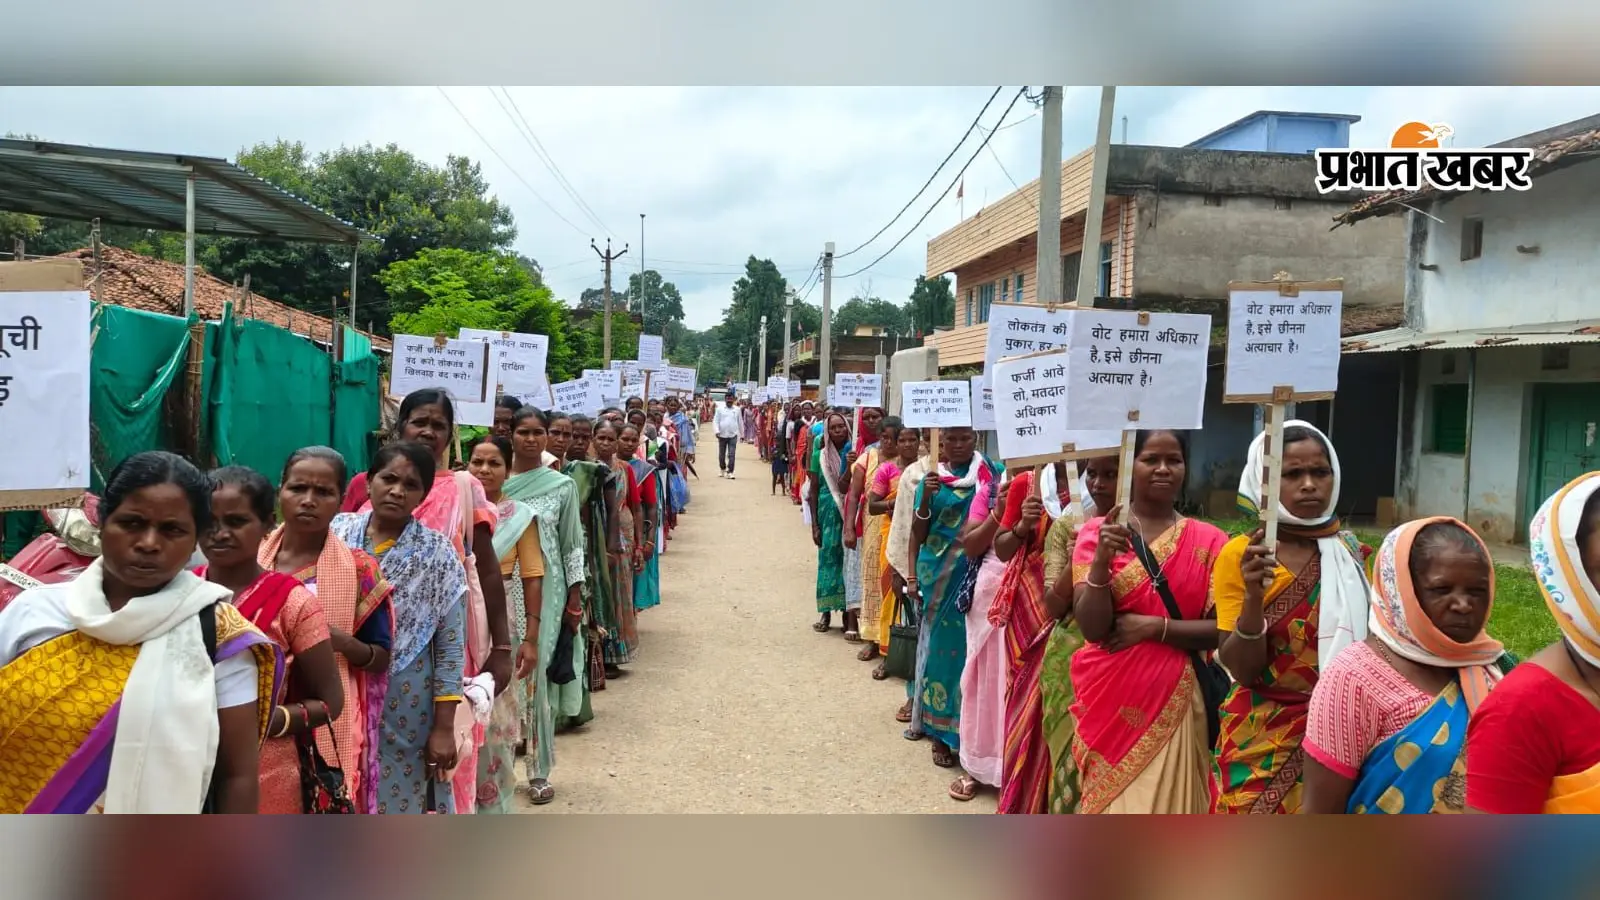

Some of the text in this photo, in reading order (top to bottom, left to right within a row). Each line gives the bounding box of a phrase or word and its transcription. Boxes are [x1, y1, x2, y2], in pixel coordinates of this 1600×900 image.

[1247, 301, 1332, 316] वोट हमारा अधिकार
[1007, 318, 1067, 335] लोकतंत्र की
[1091, 323, 1199, 344] वोट हमारा अधिकार
[1258, 320, 1272, 334] इसे
[1278, 320, 1306, 334] छीनना
[1005, 338, 1035, 351] पुकार,
[1038, 341, 1053, 351] हर
[1245, 342, 1282, 353] अत्याचार
[1104, 347, 1122, 364] इसे
[1129, 348, 1162, 364] छीनना
[1011, 364, 1065, 383] फर्जी आवे
[1089, 370, 1152, 387] अत्याचार है!
[1015, 405, 1057, 418] अधिकार
